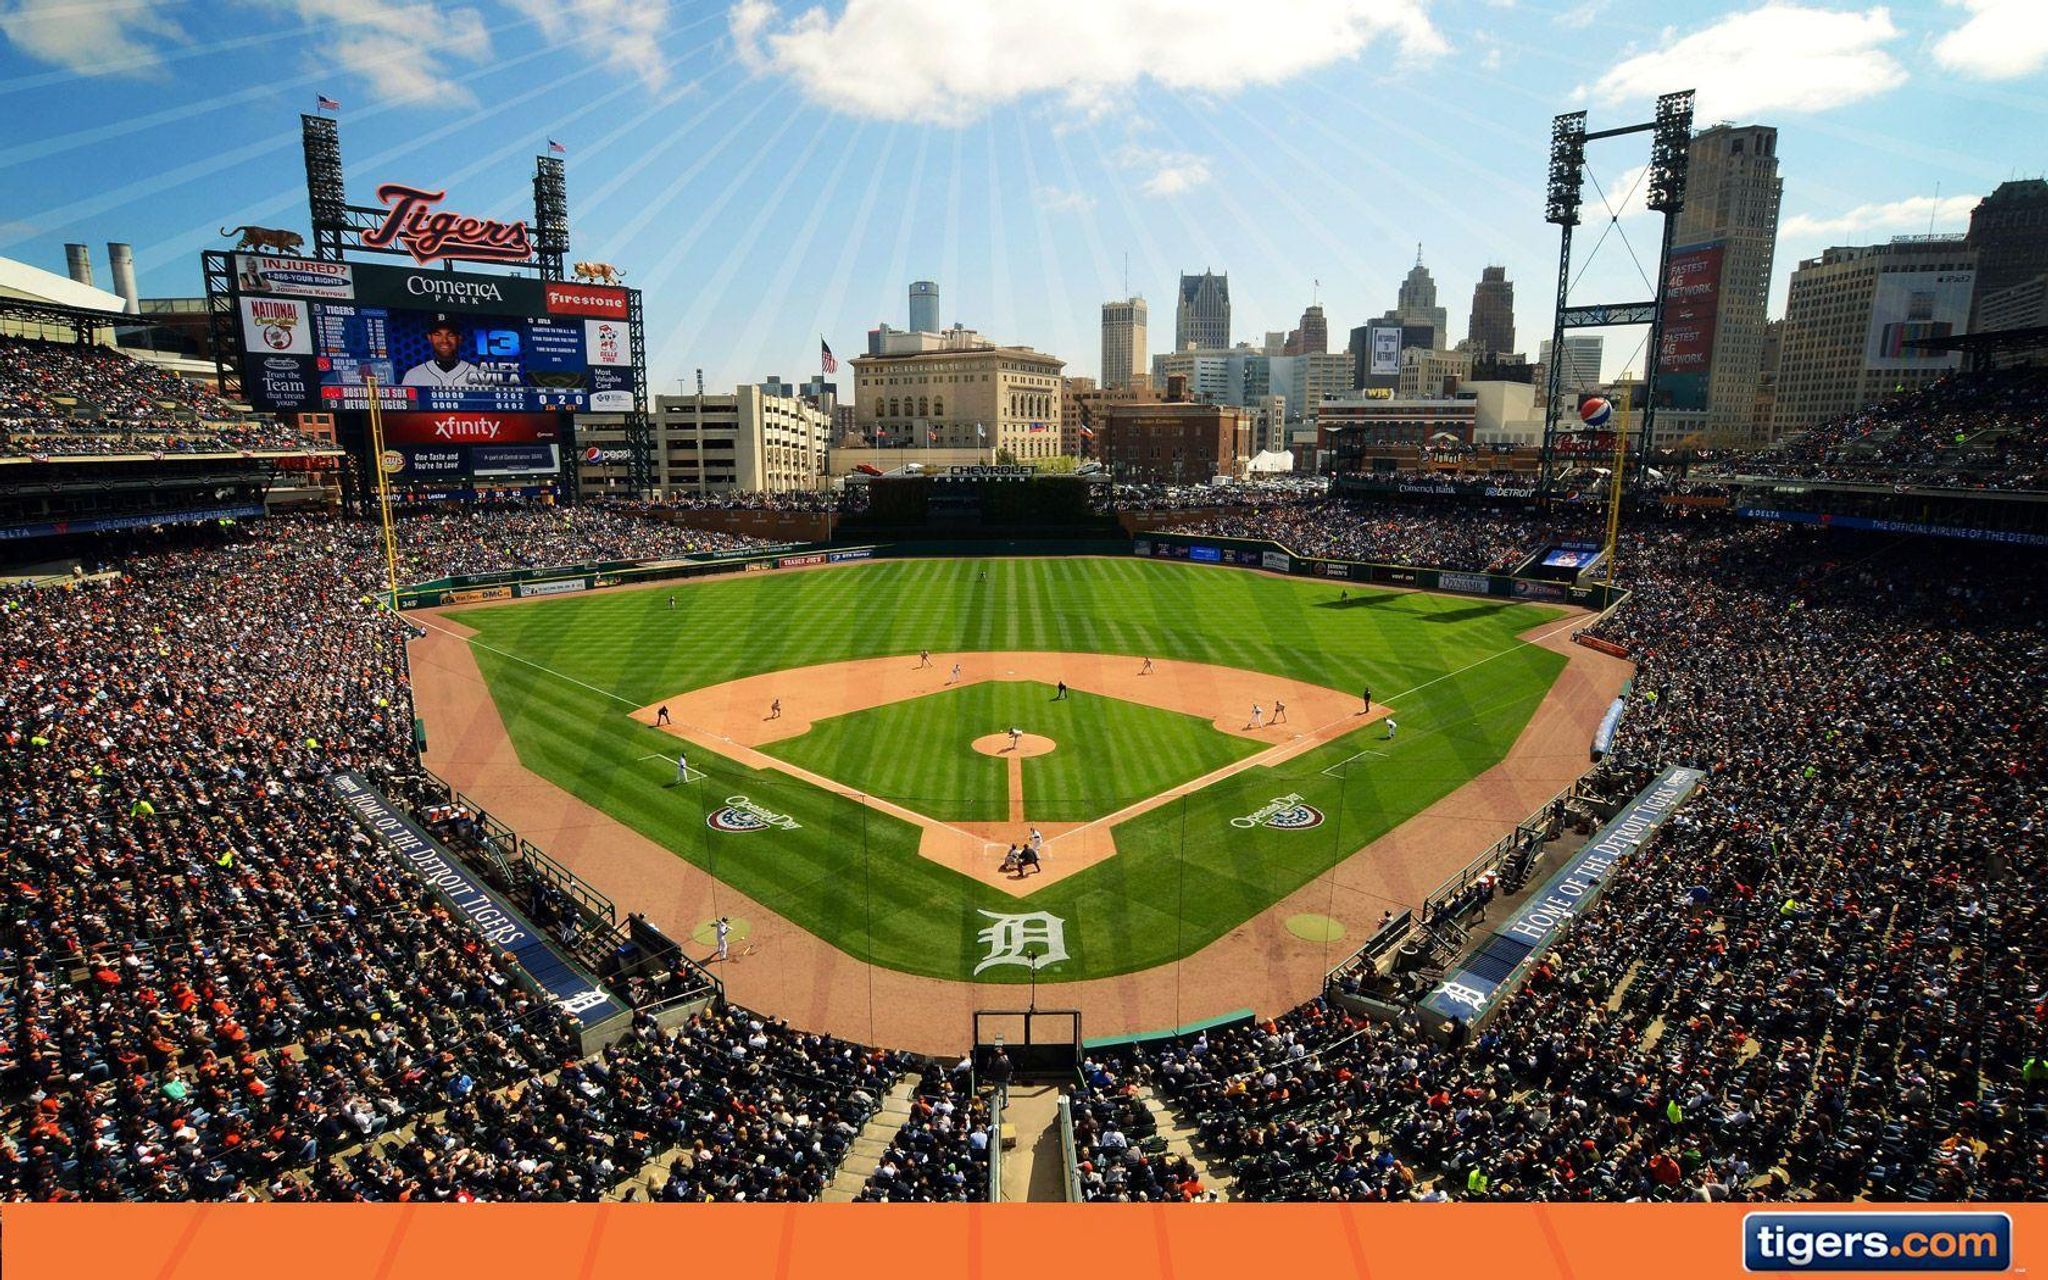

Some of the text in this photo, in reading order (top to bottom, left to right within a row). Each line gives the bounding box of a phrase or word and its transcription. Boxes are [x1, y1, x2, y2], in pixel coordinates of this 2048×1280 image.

[361, 184, 532, 265] Tigers
[263, 259, 347, 275] INJURED?
[1671, 261, 1709, 276] FASTEST
[407, 275, 503, 302] Comerica
[1668, 275, 1684, 288] 4G
[434, 296, 480, 305] PARK
[549, 291, 625, 309] Firestone
[251, 301, 298, 318] NATIONAL
[325, 305, 355, 316] TIGERS
[476, 330, 520, 356] 13
[1663, 331, 1701, 343] FASTEST
[1661, 343, 1677, 355] 4G
[479, 362, 520, 373] ALEX
[265, 371, 286, 379] Trust
[467, 372, 521, 386] AVILA
[262, 378, 305, 392] Team
[435, 417, 500, 439] xfinity
[602, 449, 631, 459] pepsi
[950, 465, 1038, 475] CHEVROLET
[1435, 484, 1456, 494] Bank
[1497, 487, 1534, 497] DETROIT
[1755, 509, 1780, 518] DELTA
[1872, 519, 1888, 530] THE
[1889, 521, 1928, 534] OFFICIAL
[1929, 525, 1967, 538] AIRLINE
[1967, 528, 1983, 539] OF
[1985, 530, 2005, 542] THE
[349, 793, 525, 944] HOME OF THE DETROIT TIGERS
[1512, 788, 1679, 939] HOME OF THE DETROIT TIGERS
